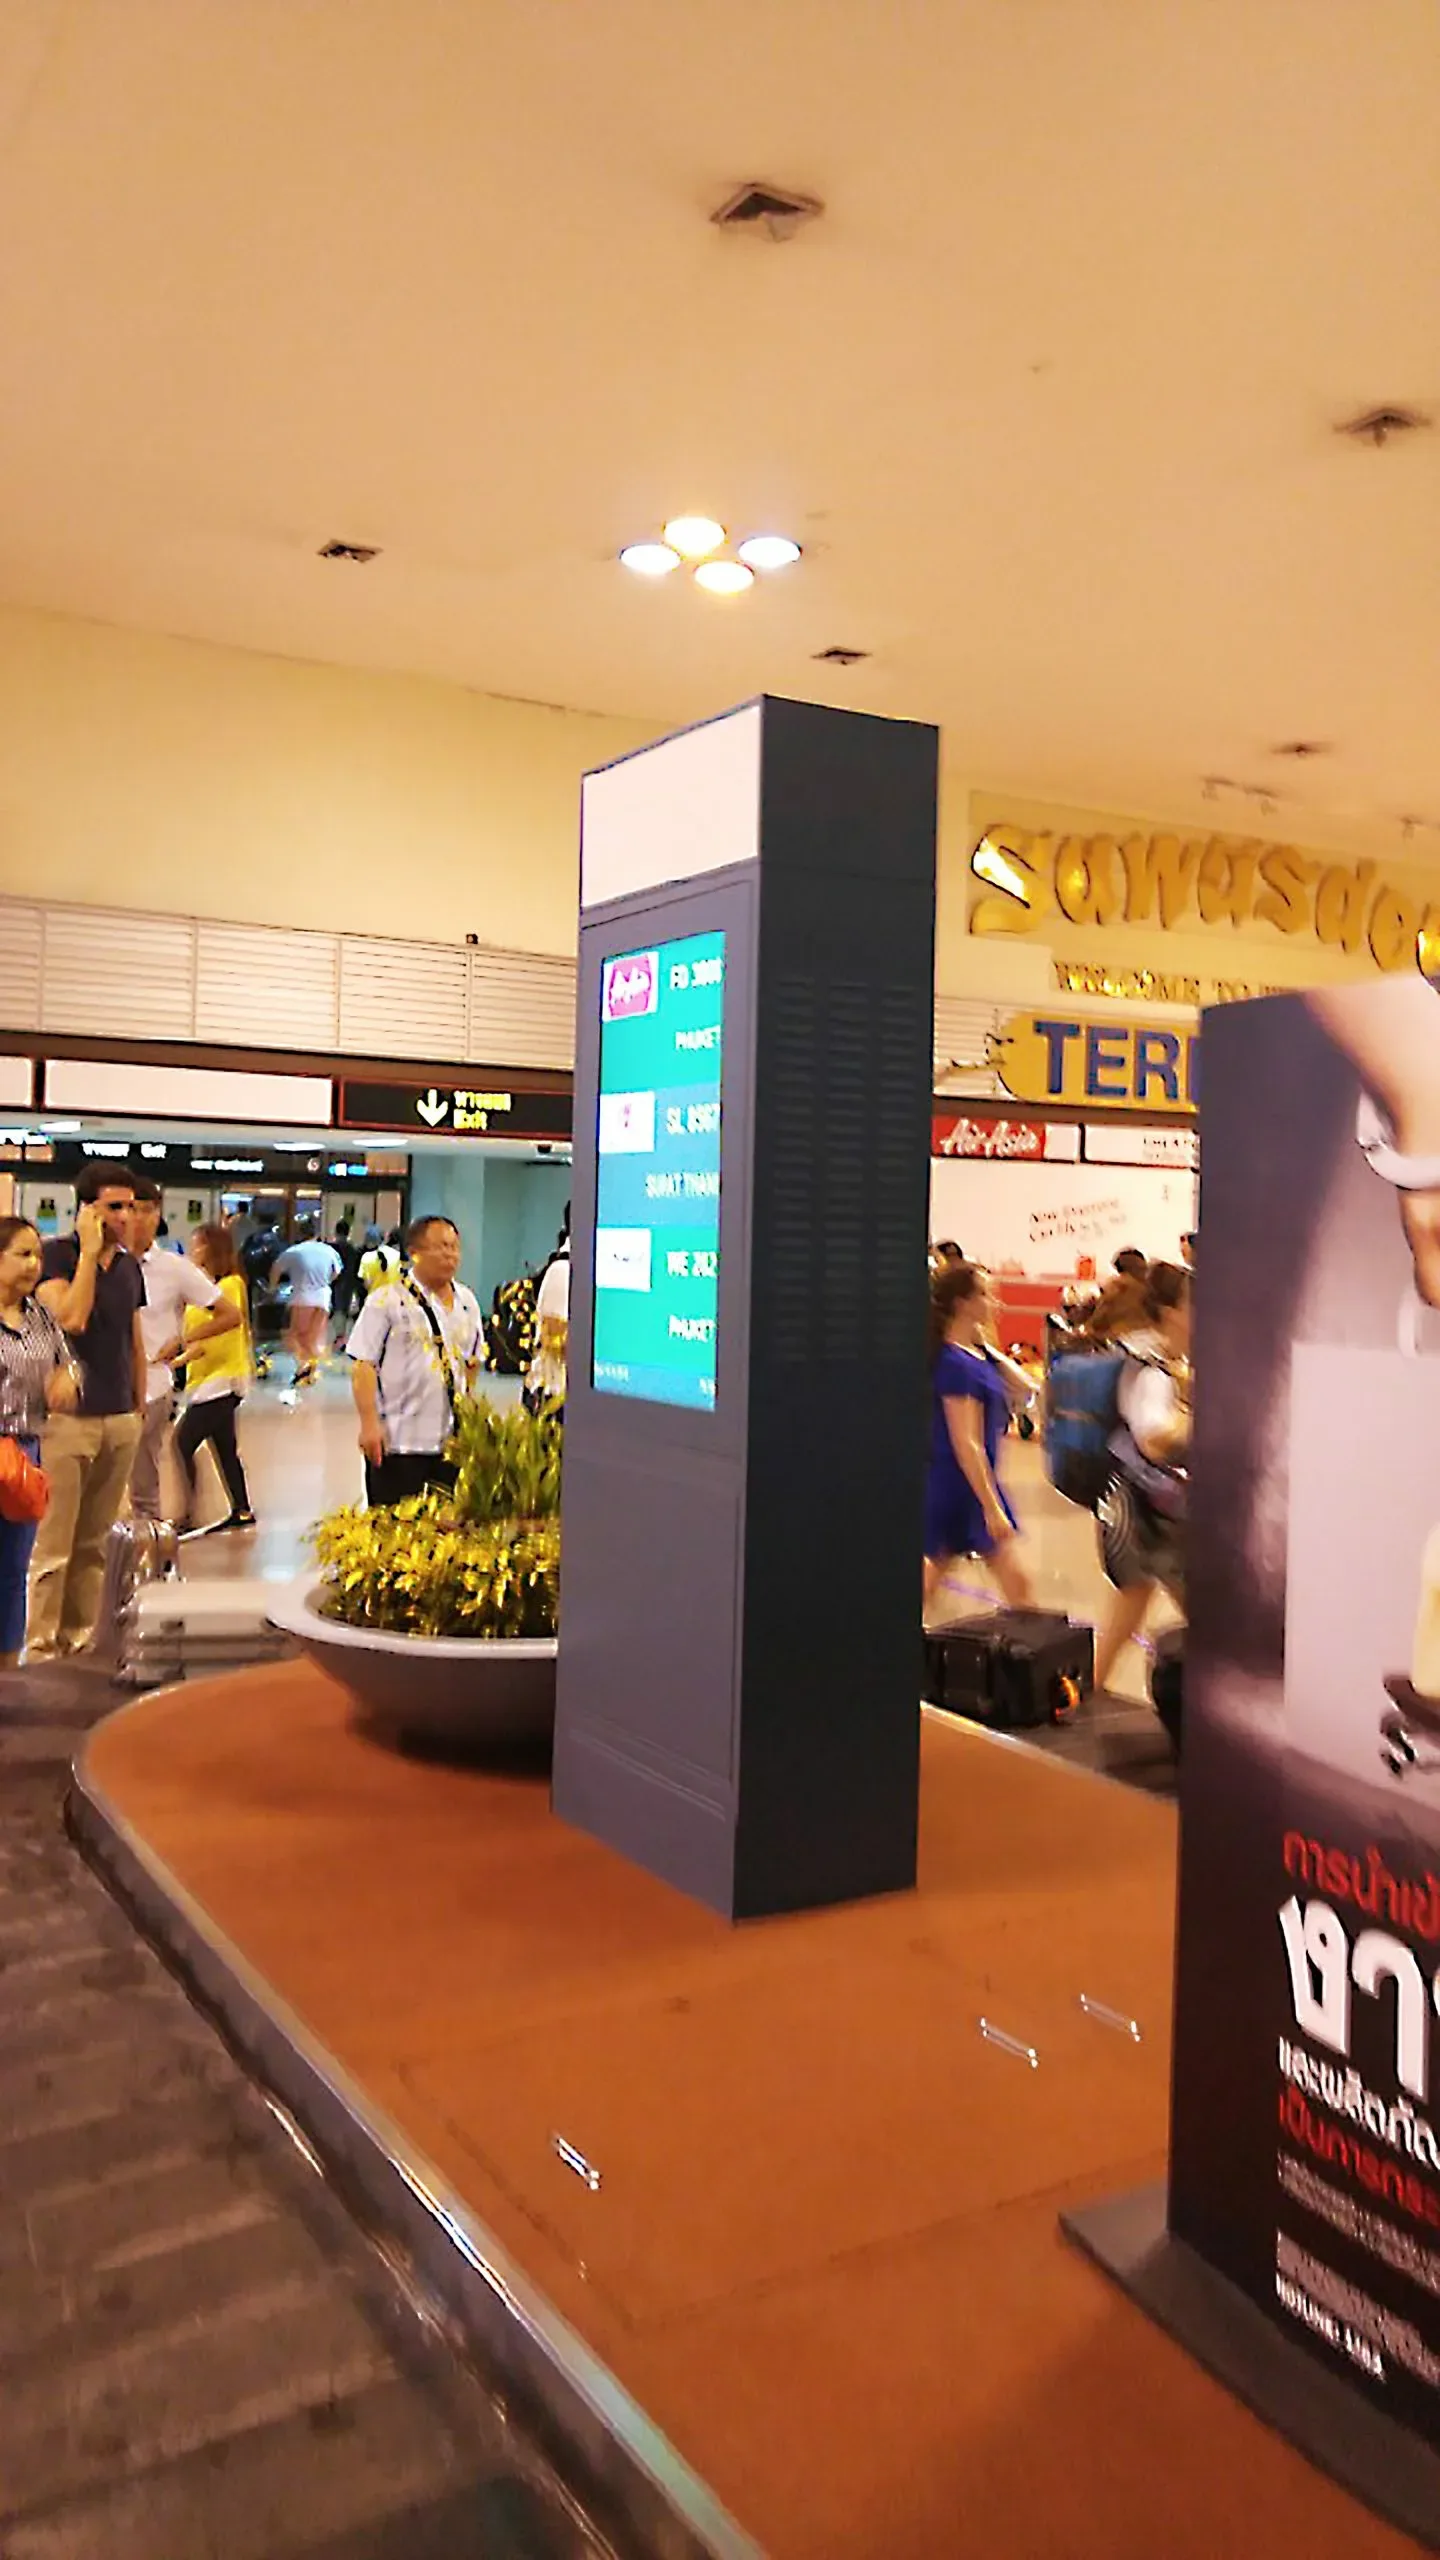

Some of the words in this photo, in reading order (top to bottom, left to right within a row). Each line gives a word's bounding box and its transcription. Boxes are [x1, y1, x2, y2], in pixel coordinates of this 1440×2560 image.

[1052, 960, 1200, 1000] WELCOME
[1033, 1020, 1201, 1105] TER
[453, 1108, 487, 1130] Exit
[1278, 1894, 1440, 2102] งา
